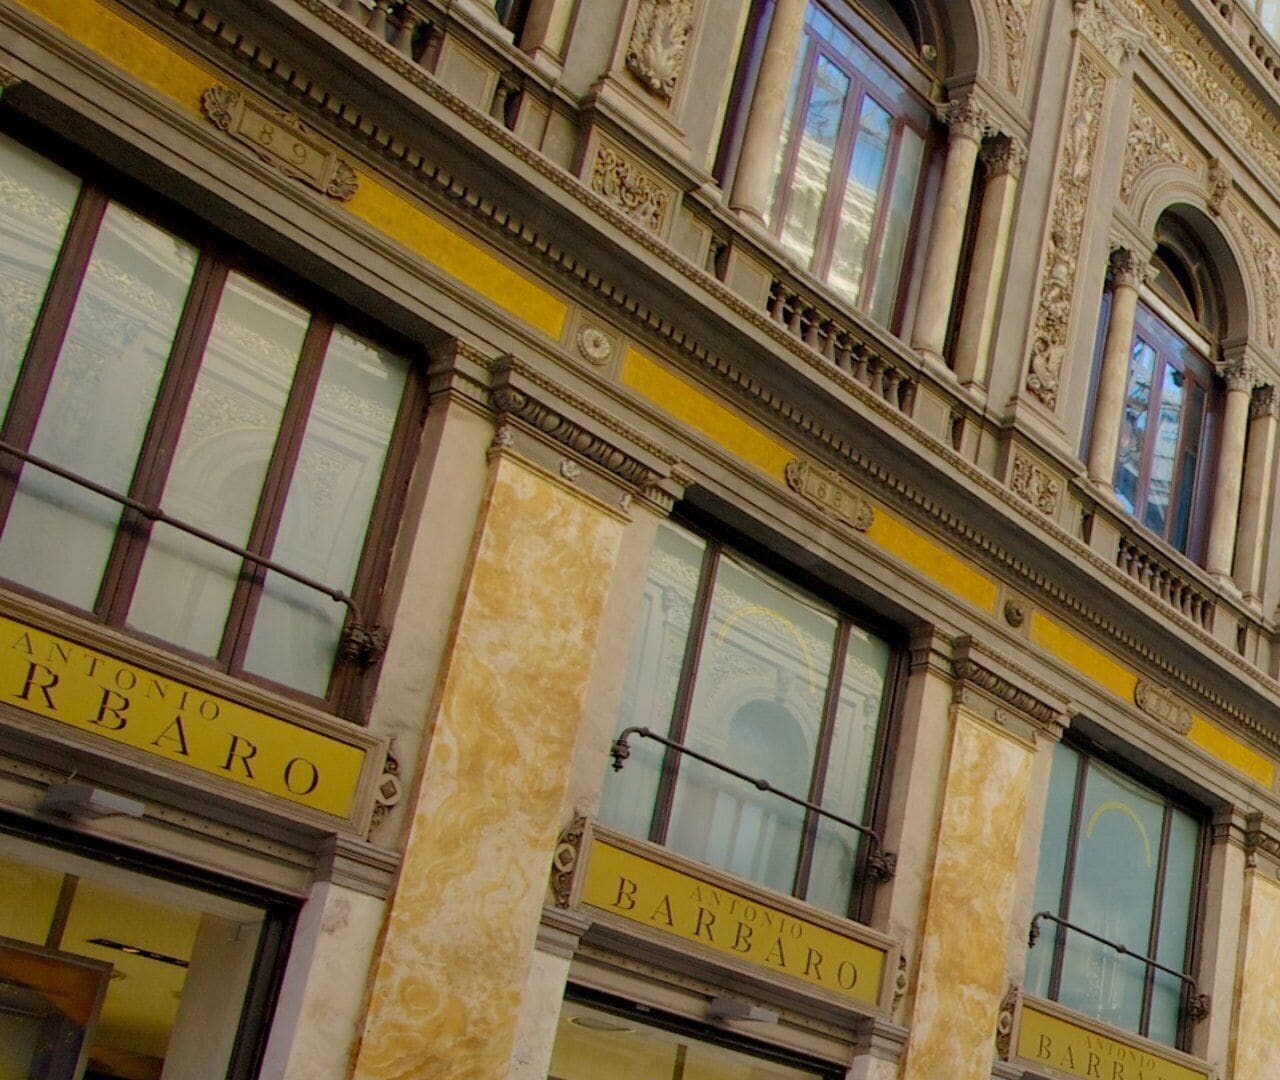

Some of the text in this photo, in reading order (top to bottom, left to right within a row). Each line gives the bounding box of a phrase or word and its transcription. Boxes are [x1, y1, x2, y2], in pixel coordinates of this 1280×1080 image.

[259, 123, 308, 166] 89
[8, 631, 221, 722] ANTONIO
[13, 660, 321, 797] RBARO
[610, 874, 859, 992] BARBARO
[688, 883, 804, 940] ANTONIO
